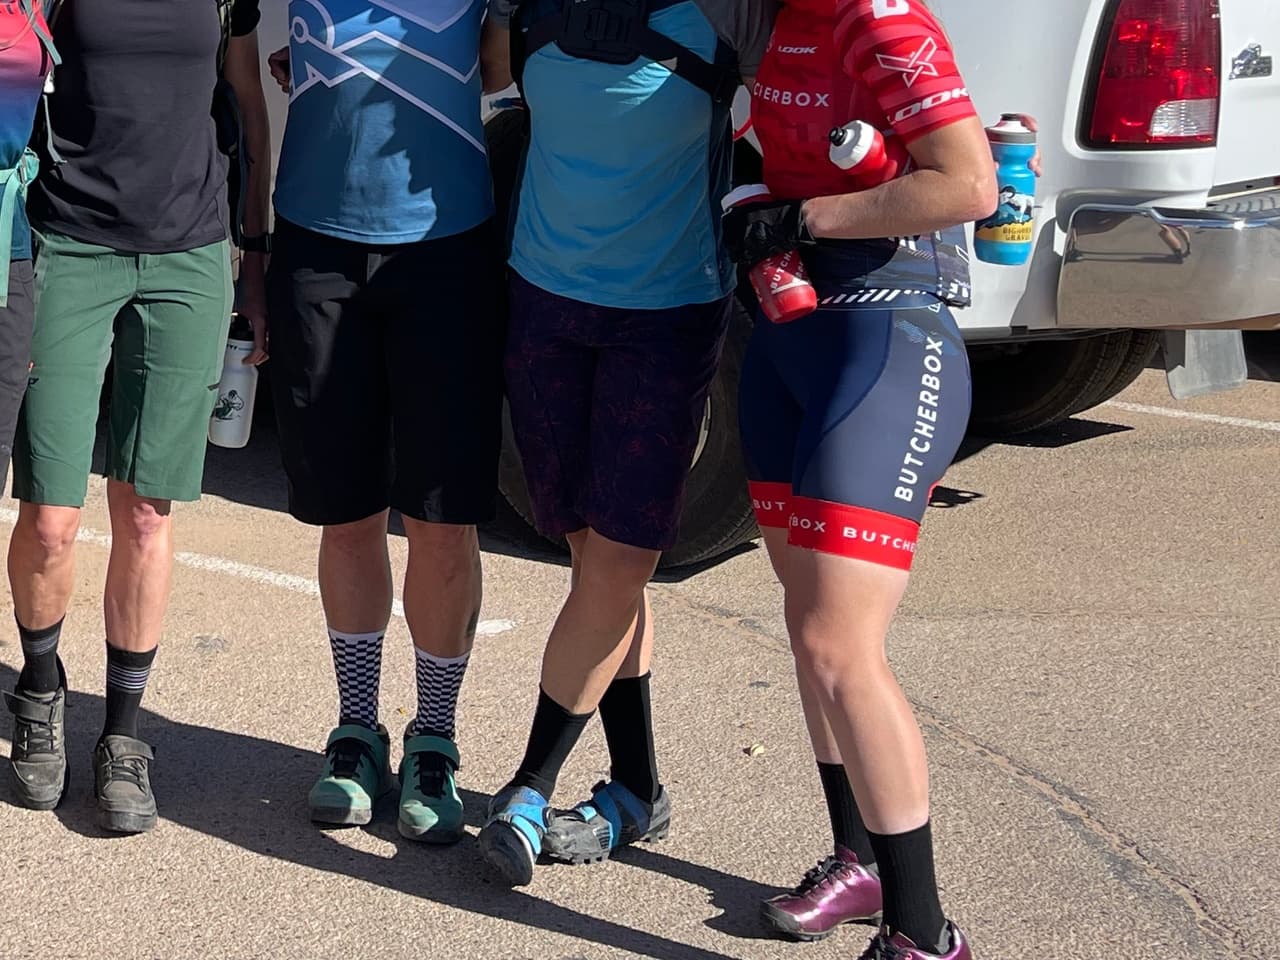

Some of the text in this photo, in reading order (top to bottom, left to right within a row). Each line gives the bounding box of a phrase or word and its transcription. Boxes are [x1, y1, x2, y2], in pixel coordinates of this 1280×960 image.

[778, 45, 818, 54] LOOK
[886, 87, 969, 125] LOOK
[894, 336, 943, 502] BUTCHERBOX
[789, 513, 827, 533] BOX
